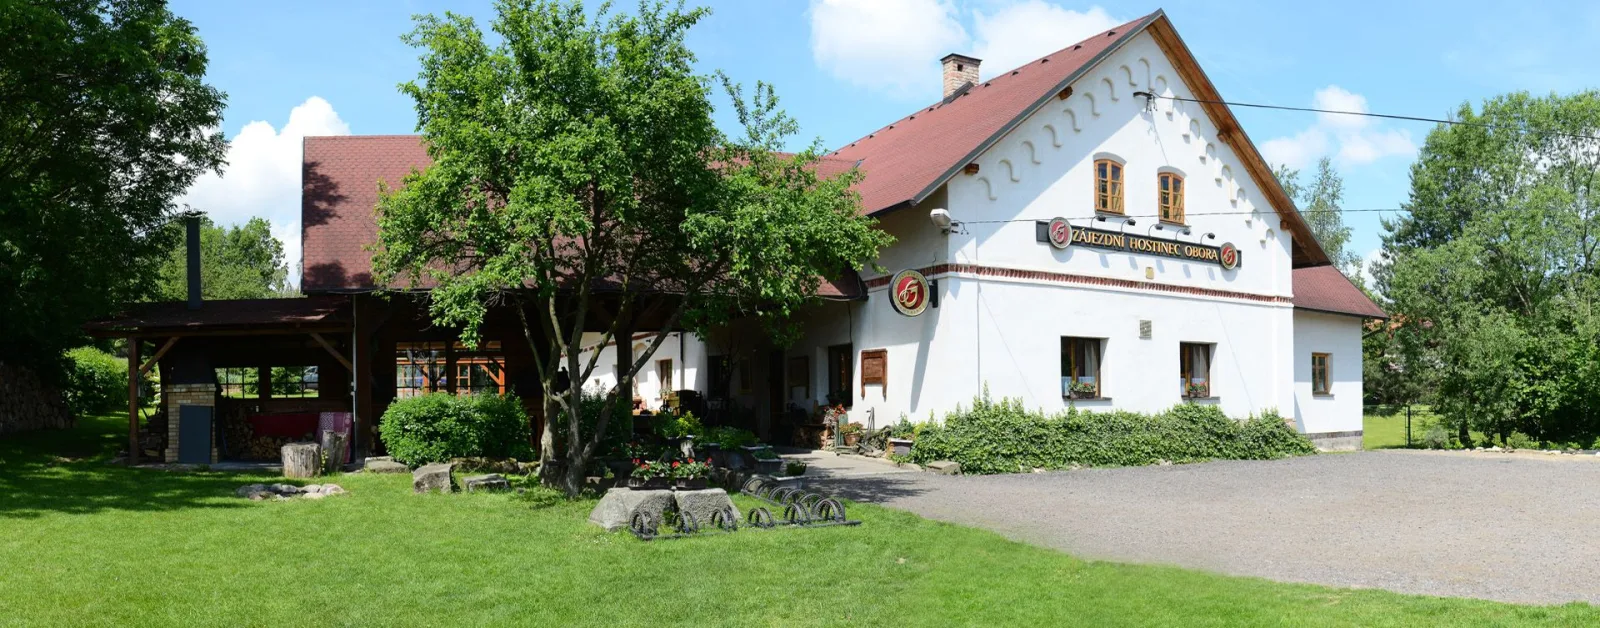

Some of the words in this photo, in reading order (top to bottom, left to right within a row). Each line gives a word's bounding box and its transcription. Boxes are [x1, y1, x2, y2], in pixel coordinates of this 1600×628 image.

[1072, 228, 1125, 248] ZÁJEZDNÍ
[1129, 237, 1181, 256] HOSTINEC
[1184, 245, 1219, 261] OBORA
